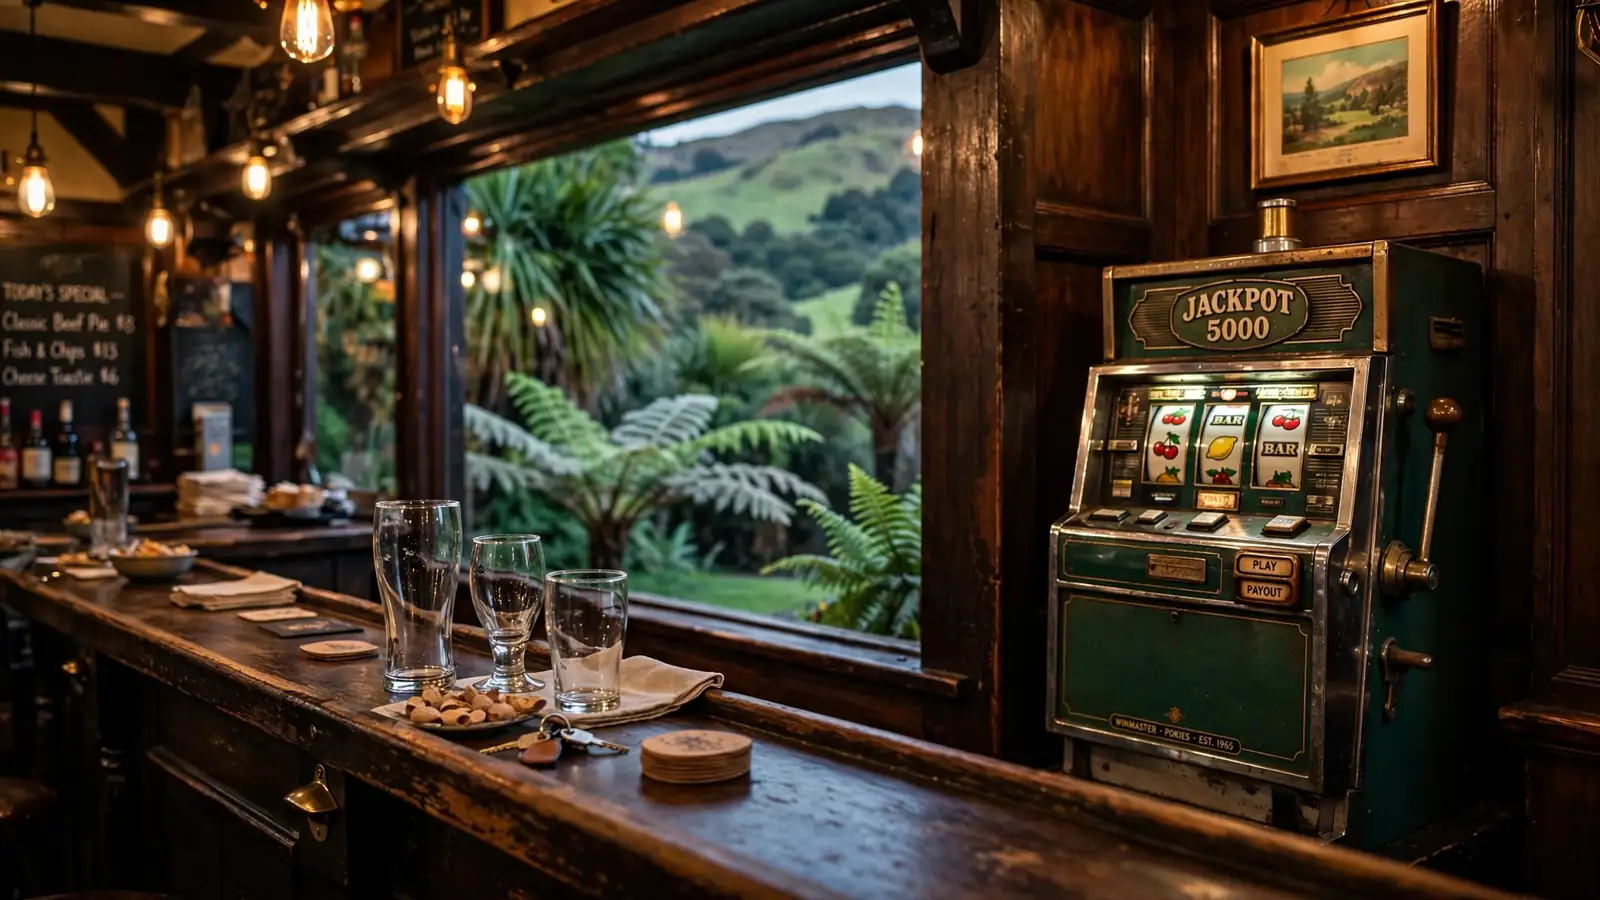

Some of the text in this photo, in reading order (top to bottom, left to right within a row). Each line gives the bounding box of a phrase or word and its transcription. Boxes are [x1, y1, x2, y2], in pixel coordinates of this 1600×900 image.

[2, 282, 107, 303] TODAY'S SPECIAL
[1182, 287, 1294, 322] JACKPOT
[2, 310, 48, 332] Classic
[53, 311, 84, 332] Beef
[87, 312, 110, 332] Pie
[1207, 316, 1270, 342] 5000
[2, 338, 32, 358] Fish
[50, 340, 86, 366] Chips
[2, 366, 47, 386] Cheese
[1212, 415, 1244, 426] BAR
[1264, 442, 1297, 456] BAR
[1252, 559, 1278, 572] PLAY
[1247, 584, 1283, 598] PAYOUT
[1115, 718, 1234, 751] WINMASTER POKIES EST. 1965
